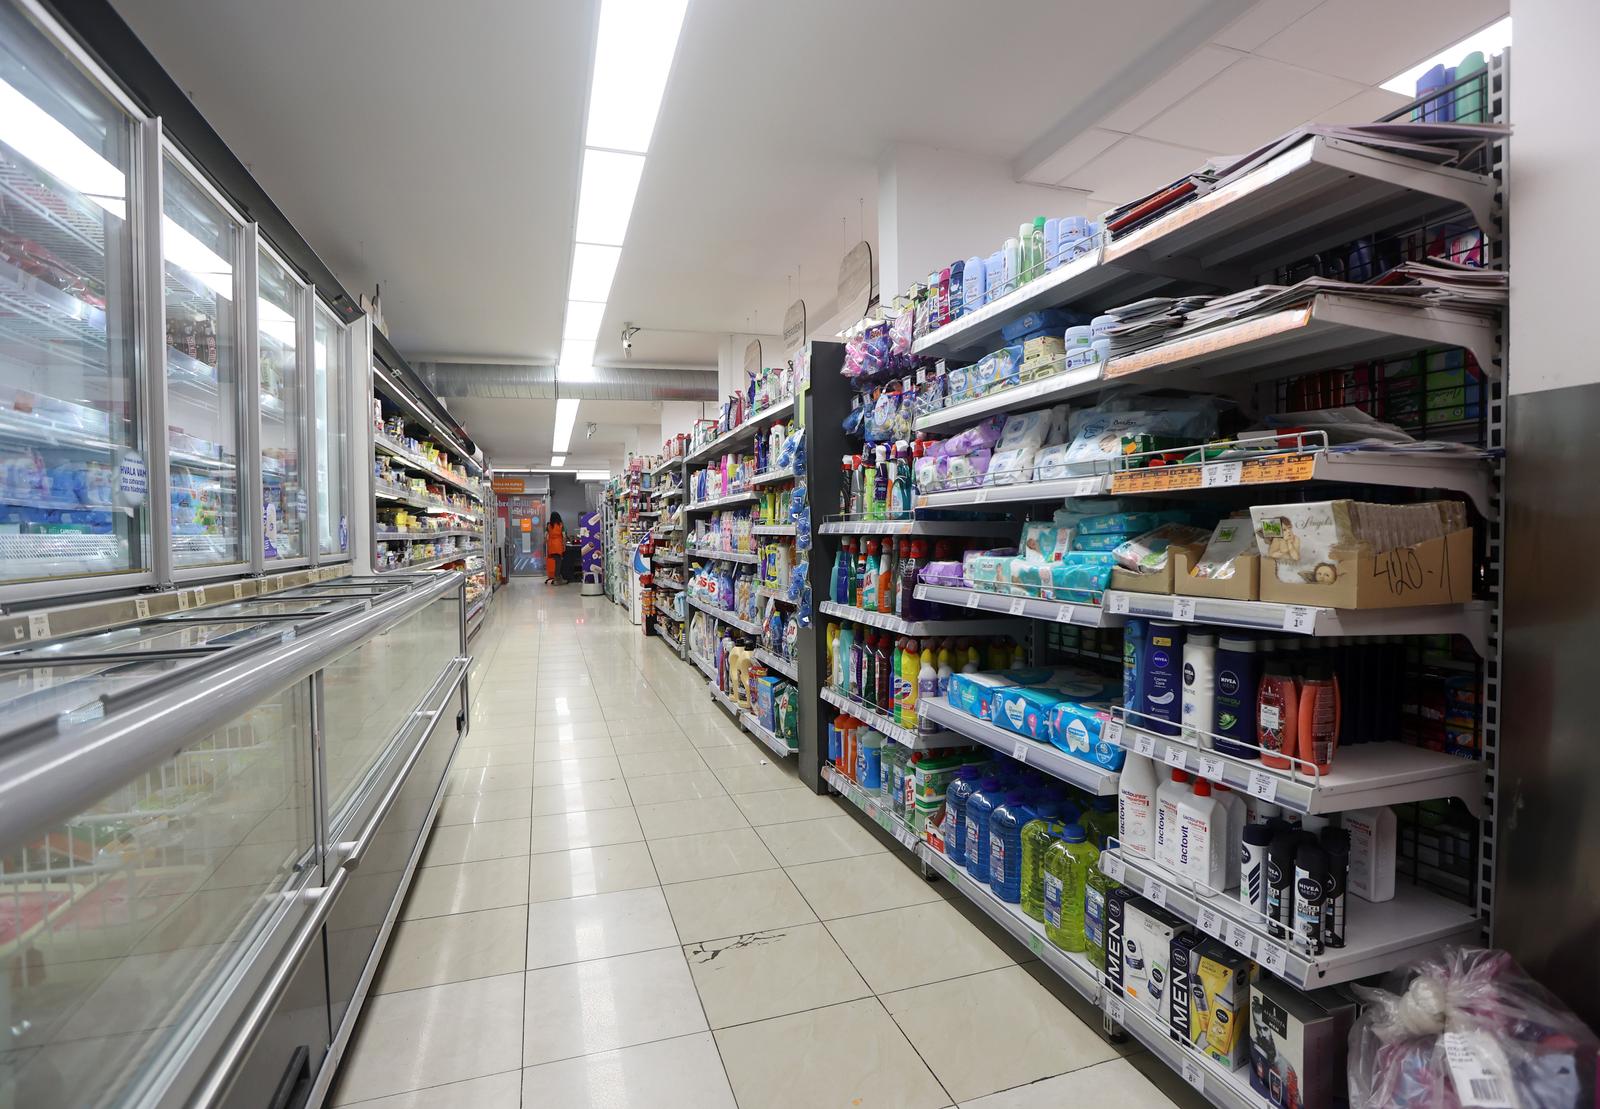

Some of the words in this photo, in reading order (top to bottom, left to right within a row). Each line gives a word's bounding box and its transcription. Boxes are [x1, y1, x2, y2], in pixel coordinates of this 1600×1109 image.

[120, 466, 136, 476] HVALA
[1220, 677, 1236, 685] NIVEA
[1180, 825, 1189, 865] lactovit
[1299, 883, 1319, 893] NIVEA
[1108, 918, 1121, 979] MEN
[1172, 967, 1188, 1029] MEN
